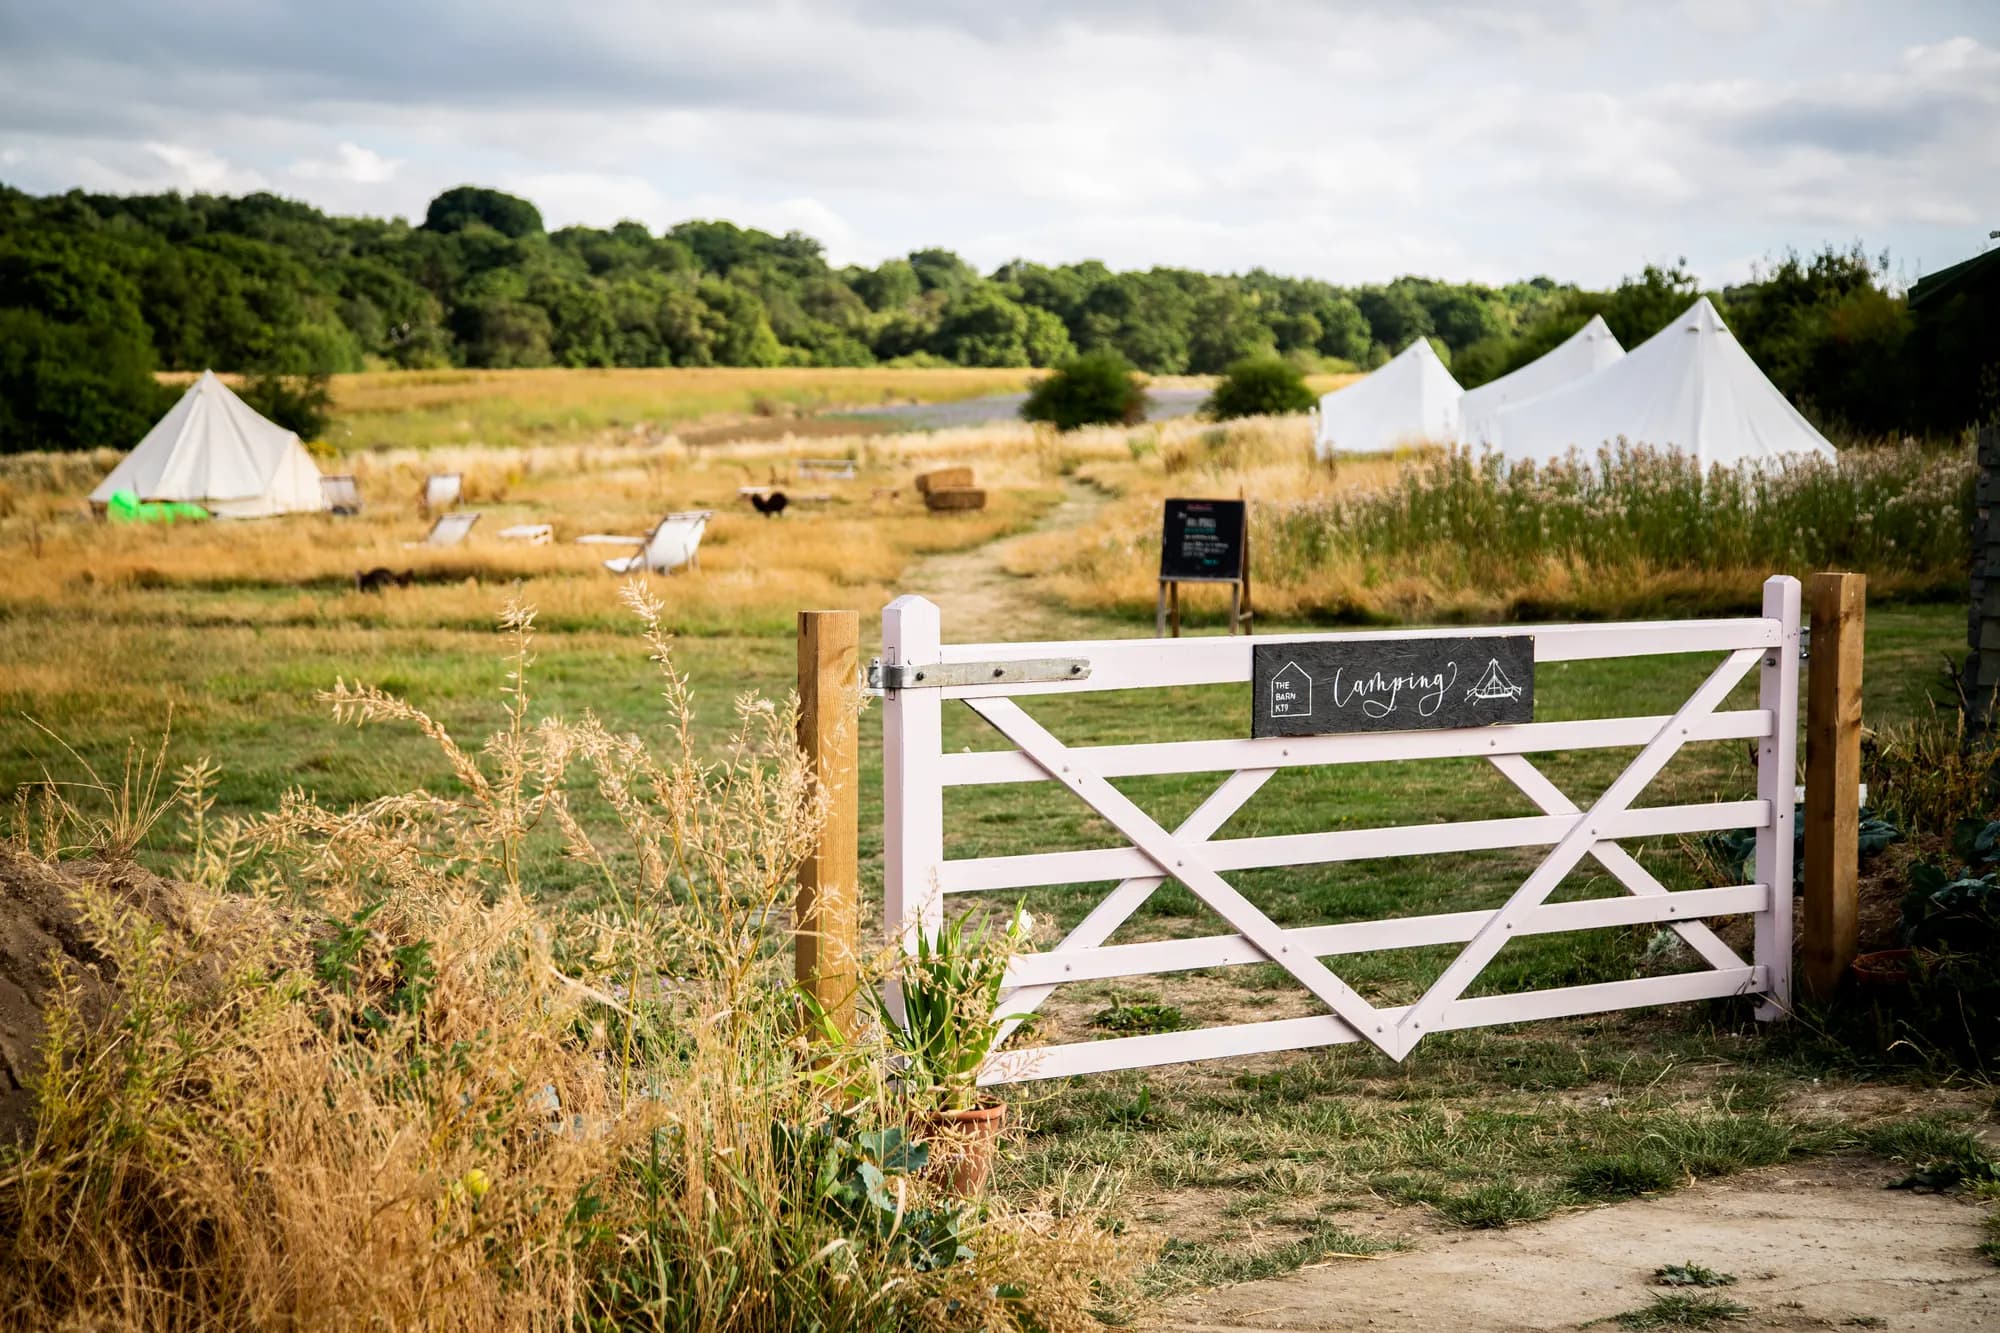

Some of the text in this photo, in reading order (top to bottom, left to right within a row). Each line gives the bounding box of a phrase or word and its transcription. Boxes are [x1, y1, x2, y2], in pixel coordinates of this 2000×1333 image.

[1275, 681, 1290, 690] THE
[1334, 661, 1458, 718] Camping
[1275, 692, 1296, 701] BARN
[1275, 704, 1289, 713] KT9
